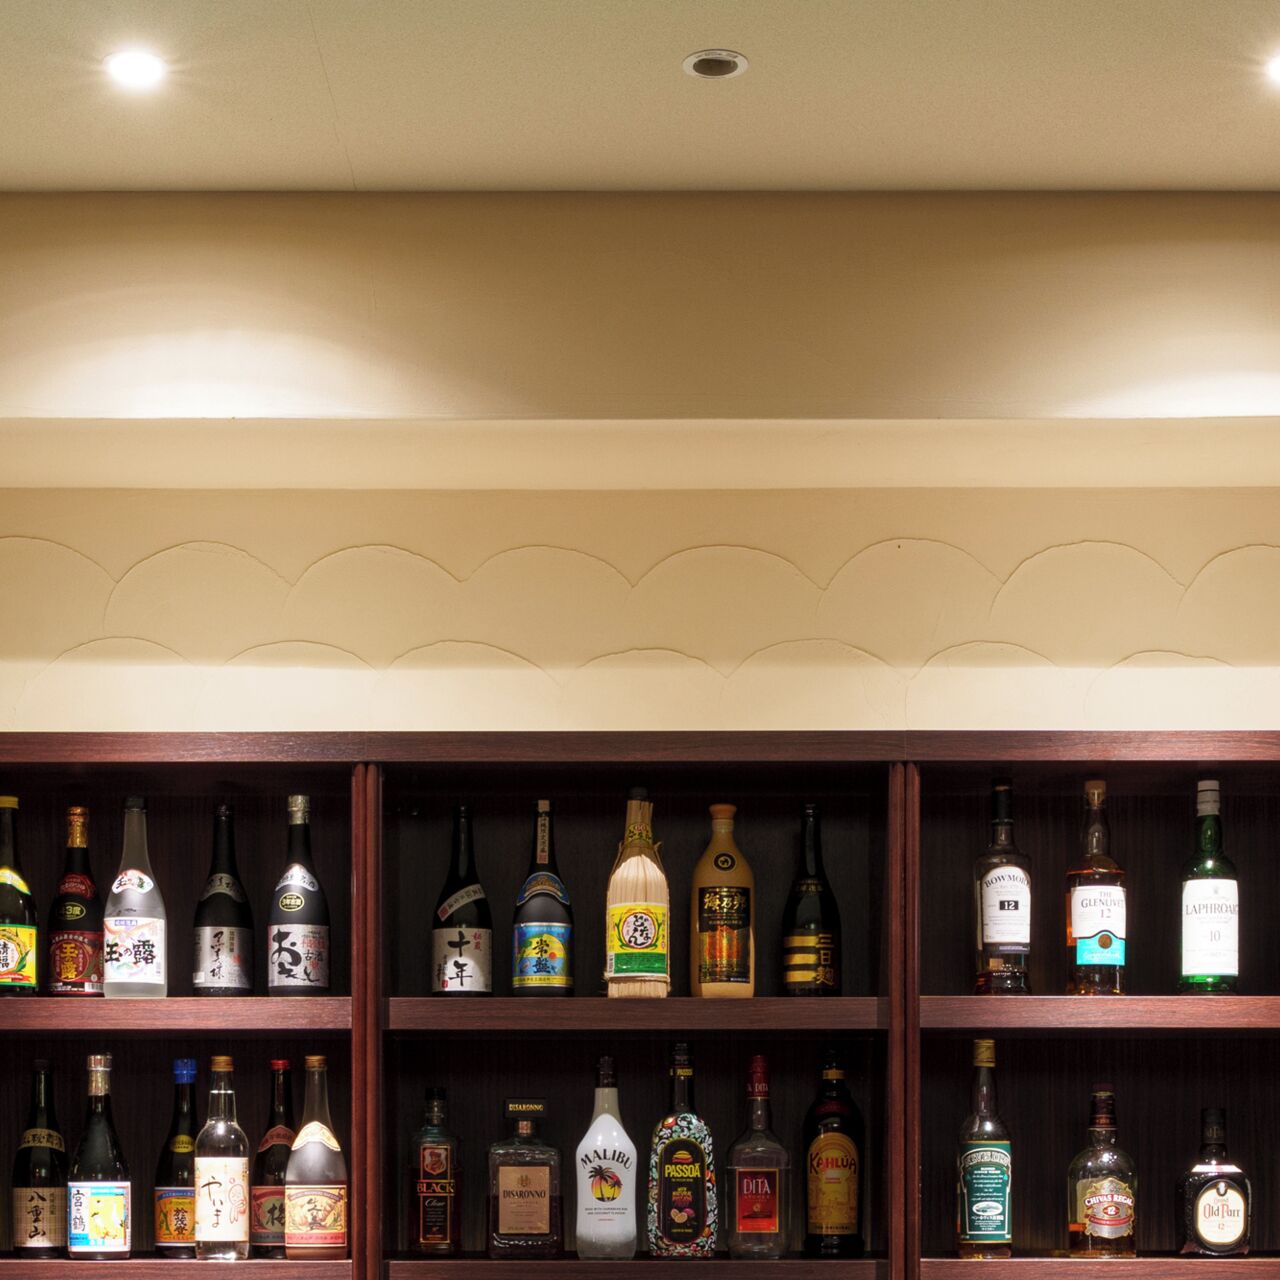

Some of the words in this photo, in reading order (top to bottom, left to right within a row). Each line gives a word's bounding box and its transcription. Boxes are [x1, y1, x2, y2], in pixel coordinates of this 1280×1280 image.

[1209, 930, 1221, 942] 10
[105, 940, 156, 965] 玉の露
[447, 930, 473, 987] 十年
[508, 1103, 545, 1112] DISARONNO
[580, 1148, 633, 1170] MALIBU
[809, 1152, 857, 1176] KAHLÚA
[417, 1183, 455, 1193] BLACK
[502, 1190, 547, 1199] DISARONNO
[201, 1176, 223, 1229] やいま
[1085, 1194, 1112, 1206] CHIVAS
[1112, 1194, 1133, 1206] REGAL
[27, 1190, 47, 1239] 八重山
[1203, 1203, 1219, 1219] Old
[1221, 1203, 1240, 1218] Parr
